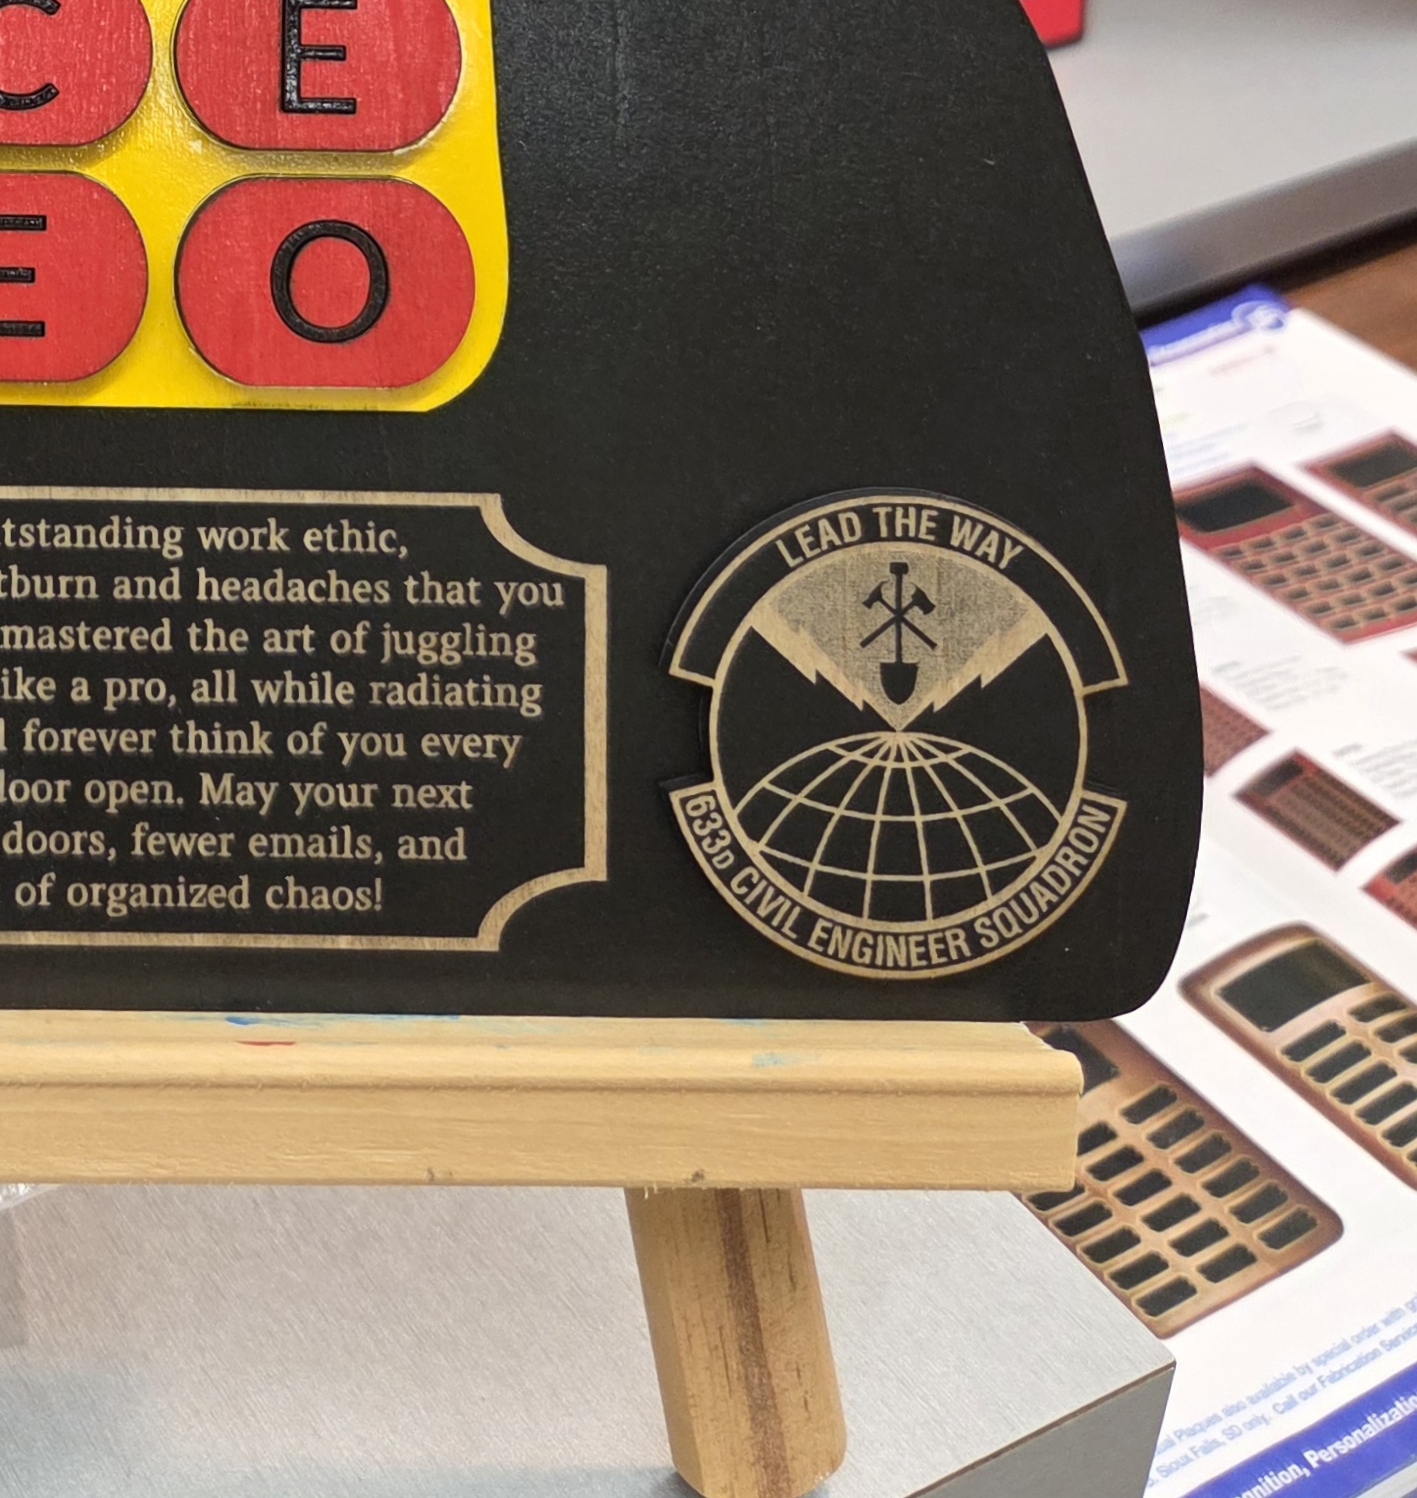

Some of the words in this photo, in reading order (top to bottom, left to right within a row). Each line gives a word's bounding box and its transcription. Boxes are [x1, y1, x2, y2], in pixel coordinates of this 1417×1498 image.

[270, 218, 391, 343] O
[196, 517, 291, 552] work
[302, 519, 409, 559] ethic,
[776, 509, 863, 568] LEAD
[873, 505, 938, 541] THE
[950, 514, 1025, 570] WAY
[112, 566, 182, 601] and
[196, 566, 391, 605] headaches
[403, 570, 482, 606] that
[493, 581, 565, 616] you
[0, 617, 173, 653] mastered
[186, 618, 250, 653] the
[262, 624, 316, 654] art
[329, 620, 371, 655] of
[381, 622, 537, 667] juggling
[70, 676, 92, 703] a
[103, 677, 177, 712] pro,
[190, 669, 238, 704] all
[250, 670, 356, 706] while
[369, 672, 543, 718] radiating
[22, 717, 157, 754] forever
[169, 719, 274, 756] think
[286, 721, 328, 756] of
[336, 731, 408, 767] you
[420, 732, 523, 769] every
[84, 779, 184, 814] open.
[199, 772, 280, 816] May
[289, 782, 379, 816] your
[391, 780, 474, 811] next
[1, 820, 117, 862] doors,
[130, 821, 235, 858] fewer
[248, 824, 383, 865] emails,
[397, 826, 468, 861] and
[14, 871, 56, 907] of
[66, 874, 251, 917] organized
[265, 875, 383, 912] chaos!
[731, 865, 800, 939] CIVIL
[808, 923, 971, 967] ENGINEER
[974, 804, 1112, 950] SQUADRON
